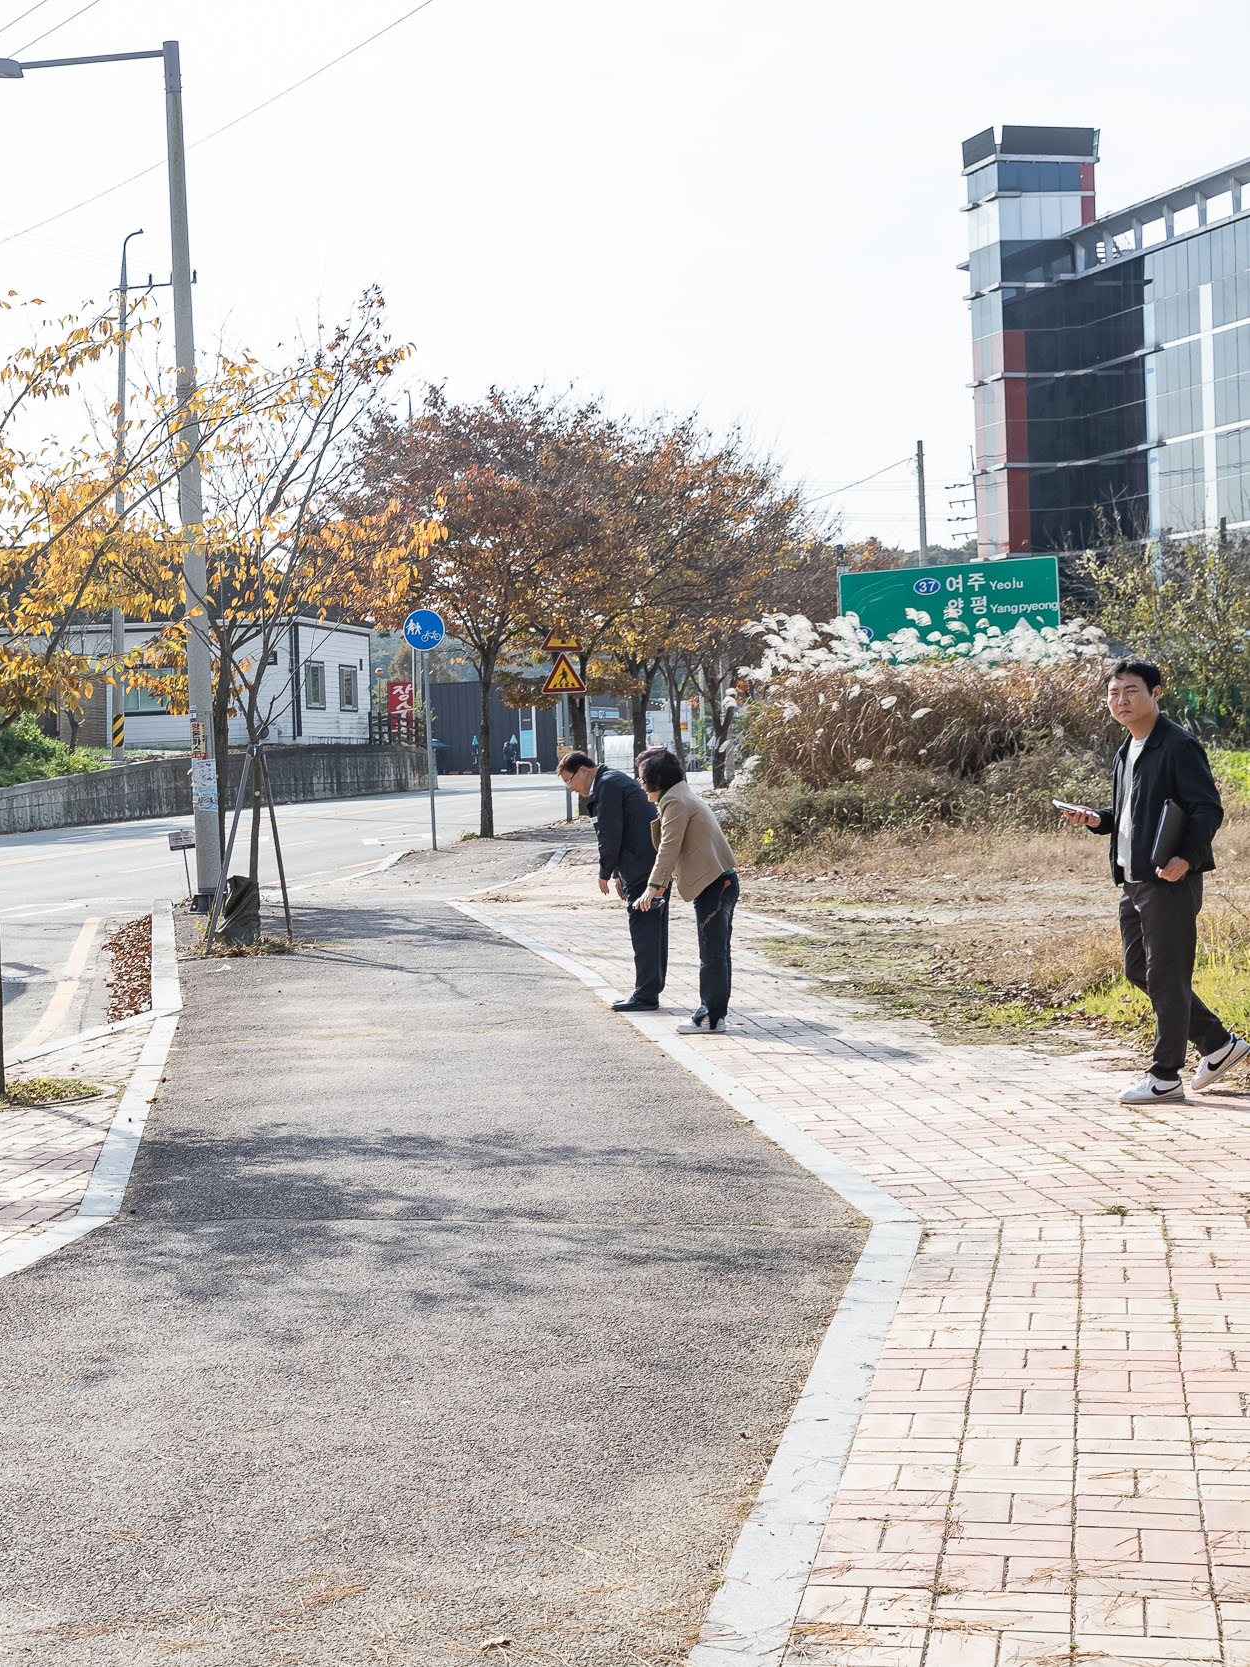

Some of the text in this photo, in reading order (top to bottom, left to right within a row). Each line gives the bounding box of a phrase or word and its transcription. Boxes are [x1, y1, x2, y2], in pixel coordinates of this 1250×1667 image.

[918, 573, 1024, 593] 37 여주 Yeoju
[947, 595, 1059, 616] 양평 Yangpyeong
